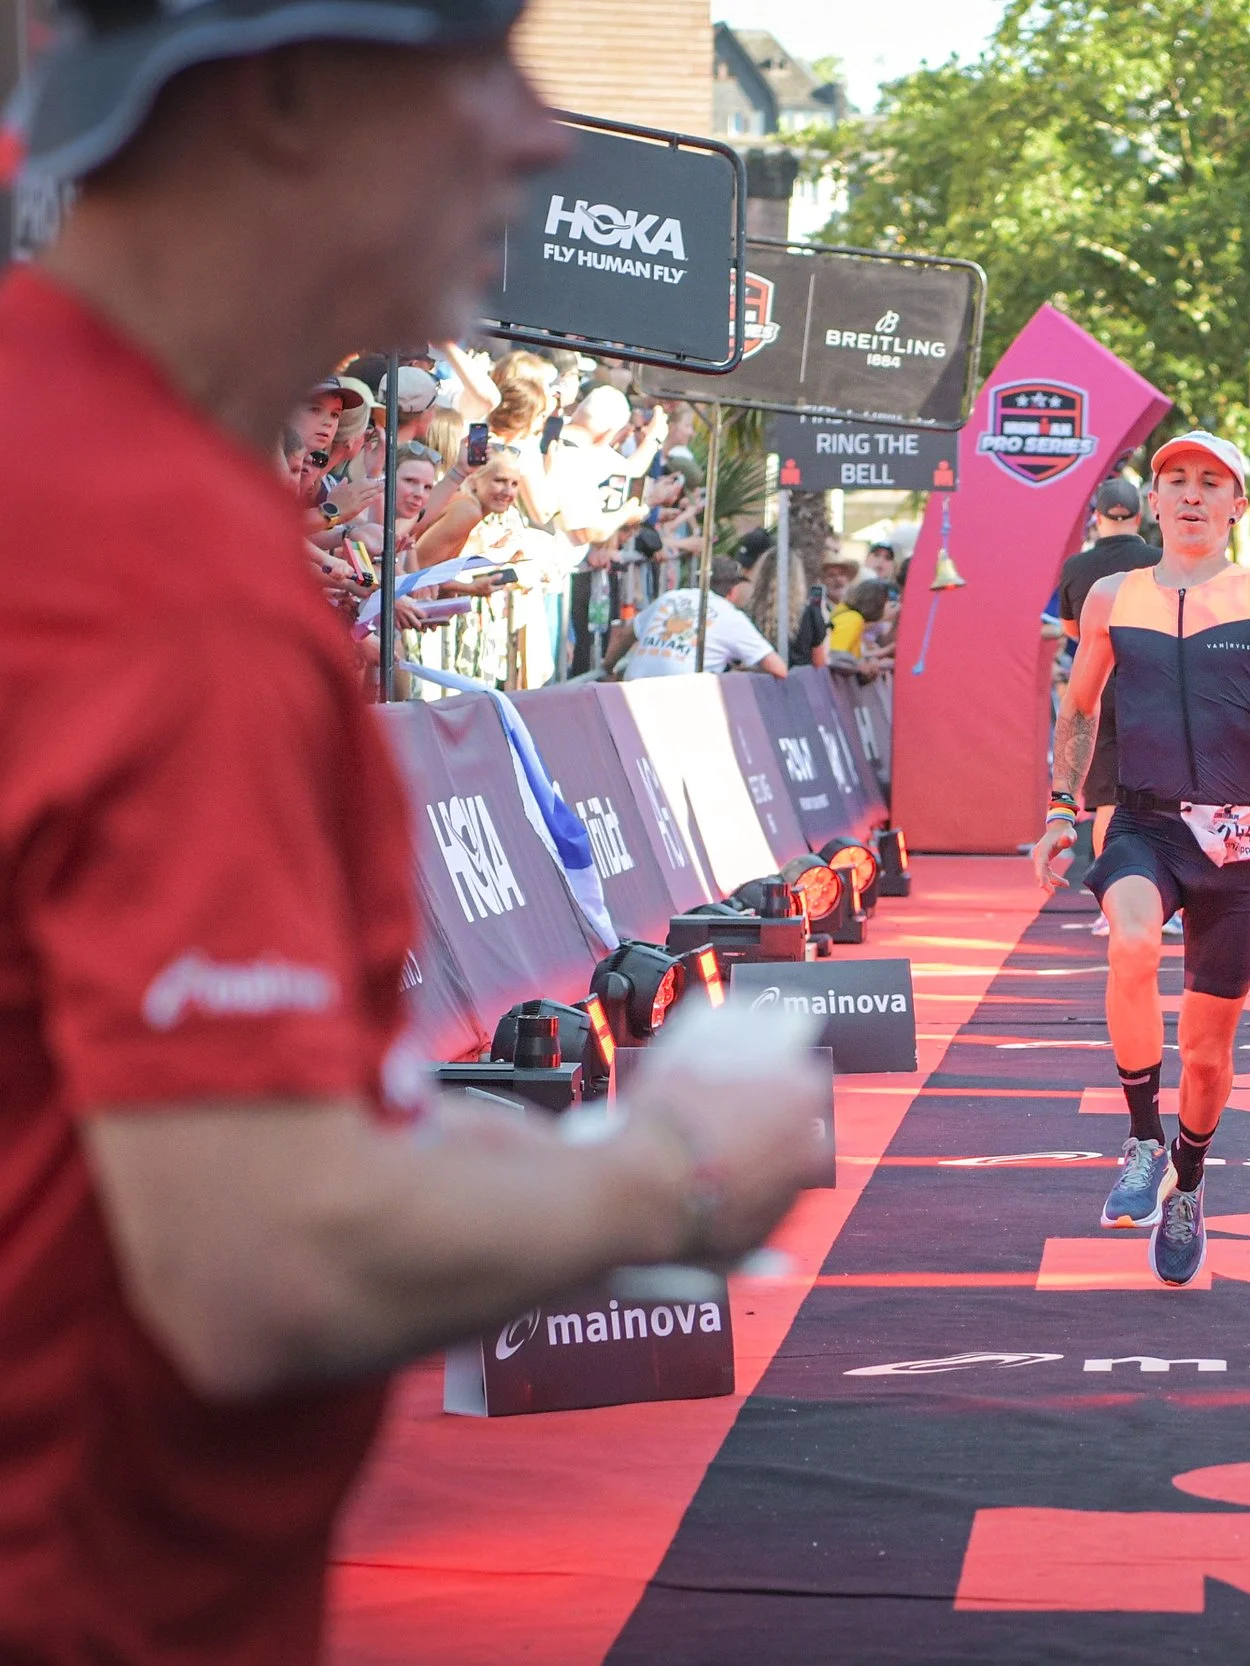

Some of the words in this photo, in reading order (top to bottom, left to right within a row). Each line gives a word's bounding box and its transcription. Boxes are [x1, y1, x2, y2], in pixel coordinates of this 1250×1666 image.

[544, 195, 688, 261] HOKA
[543, 243, 575, 262] FLY
[577, 249, 652, 280] HUMAN
[653, 265, 686, 284] FLY
[824, 329, 947, 358] BREITLING
[866, 354, 902, 369] 1884
[816, 433, 871, 454] RING
[873, 433, 919, 454] THE
[980, 435, 1023, 453] PRO
[1023, 437, 1093, 455] SERIES
[841, 463, 895, 484] BELL
[427, 794, 526, 924] HOKA
[783, 989, 907, 1015] mainova
[547, 1300, 723, 1347] mainova
